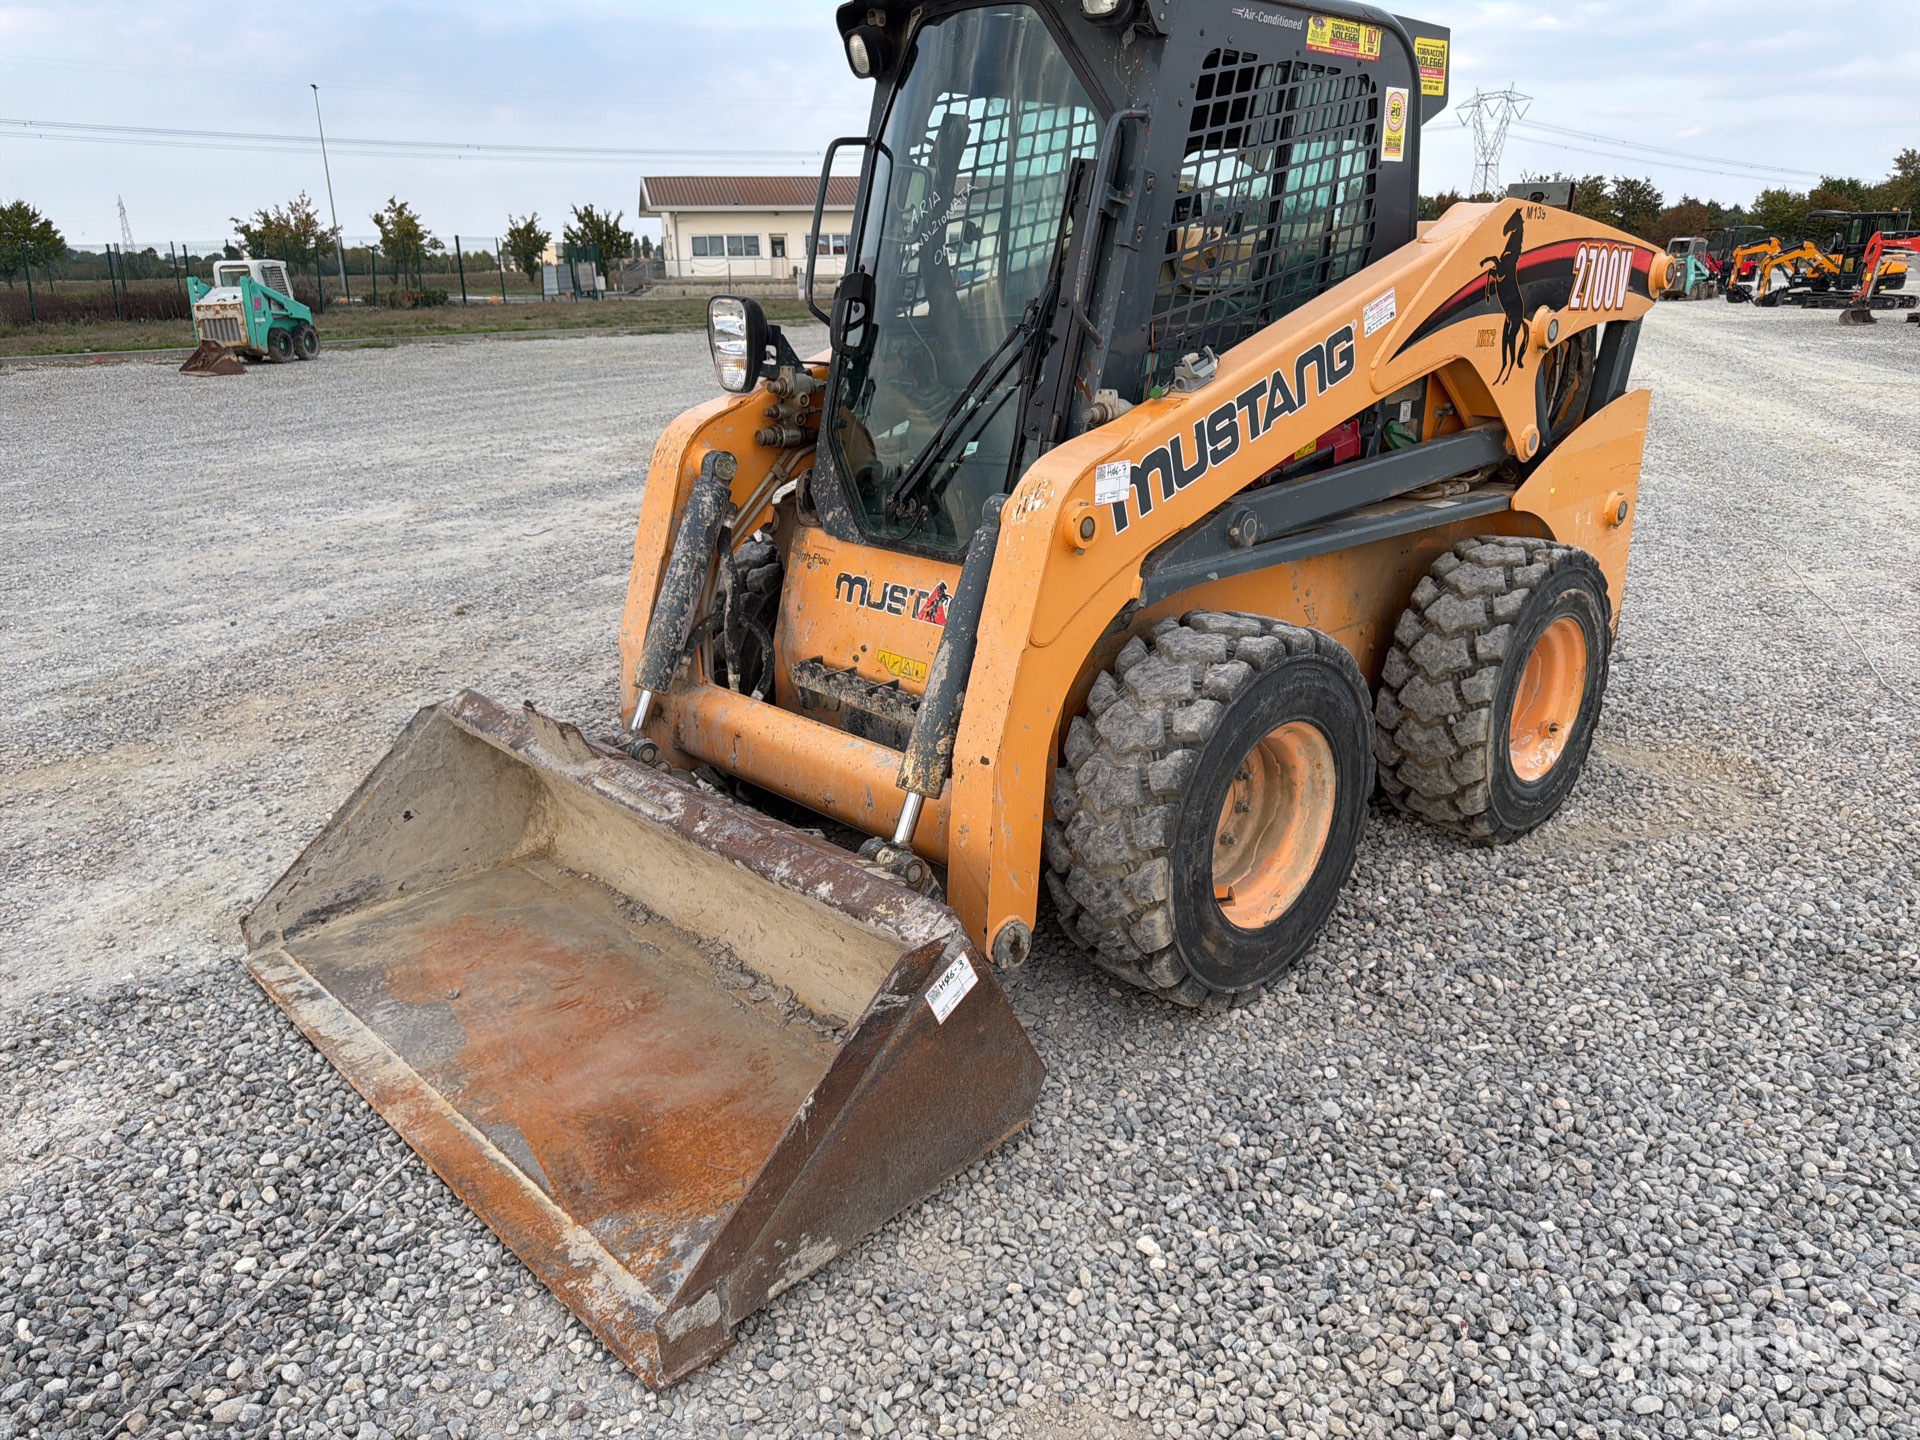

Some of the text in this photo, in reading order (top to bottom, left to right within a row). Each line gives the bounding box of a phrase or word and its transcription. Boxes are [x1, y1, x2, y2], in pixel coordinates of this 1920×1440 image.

[1243, 8, 1303, 30] Air-Conditioned
[1331, 30, 1359, 42] NOLEGGI
[911, 191, 941, 231] ARIA
[1568, 244, 1635, 312] 2700V
[797, 551, 831, 566] gh-Flow
